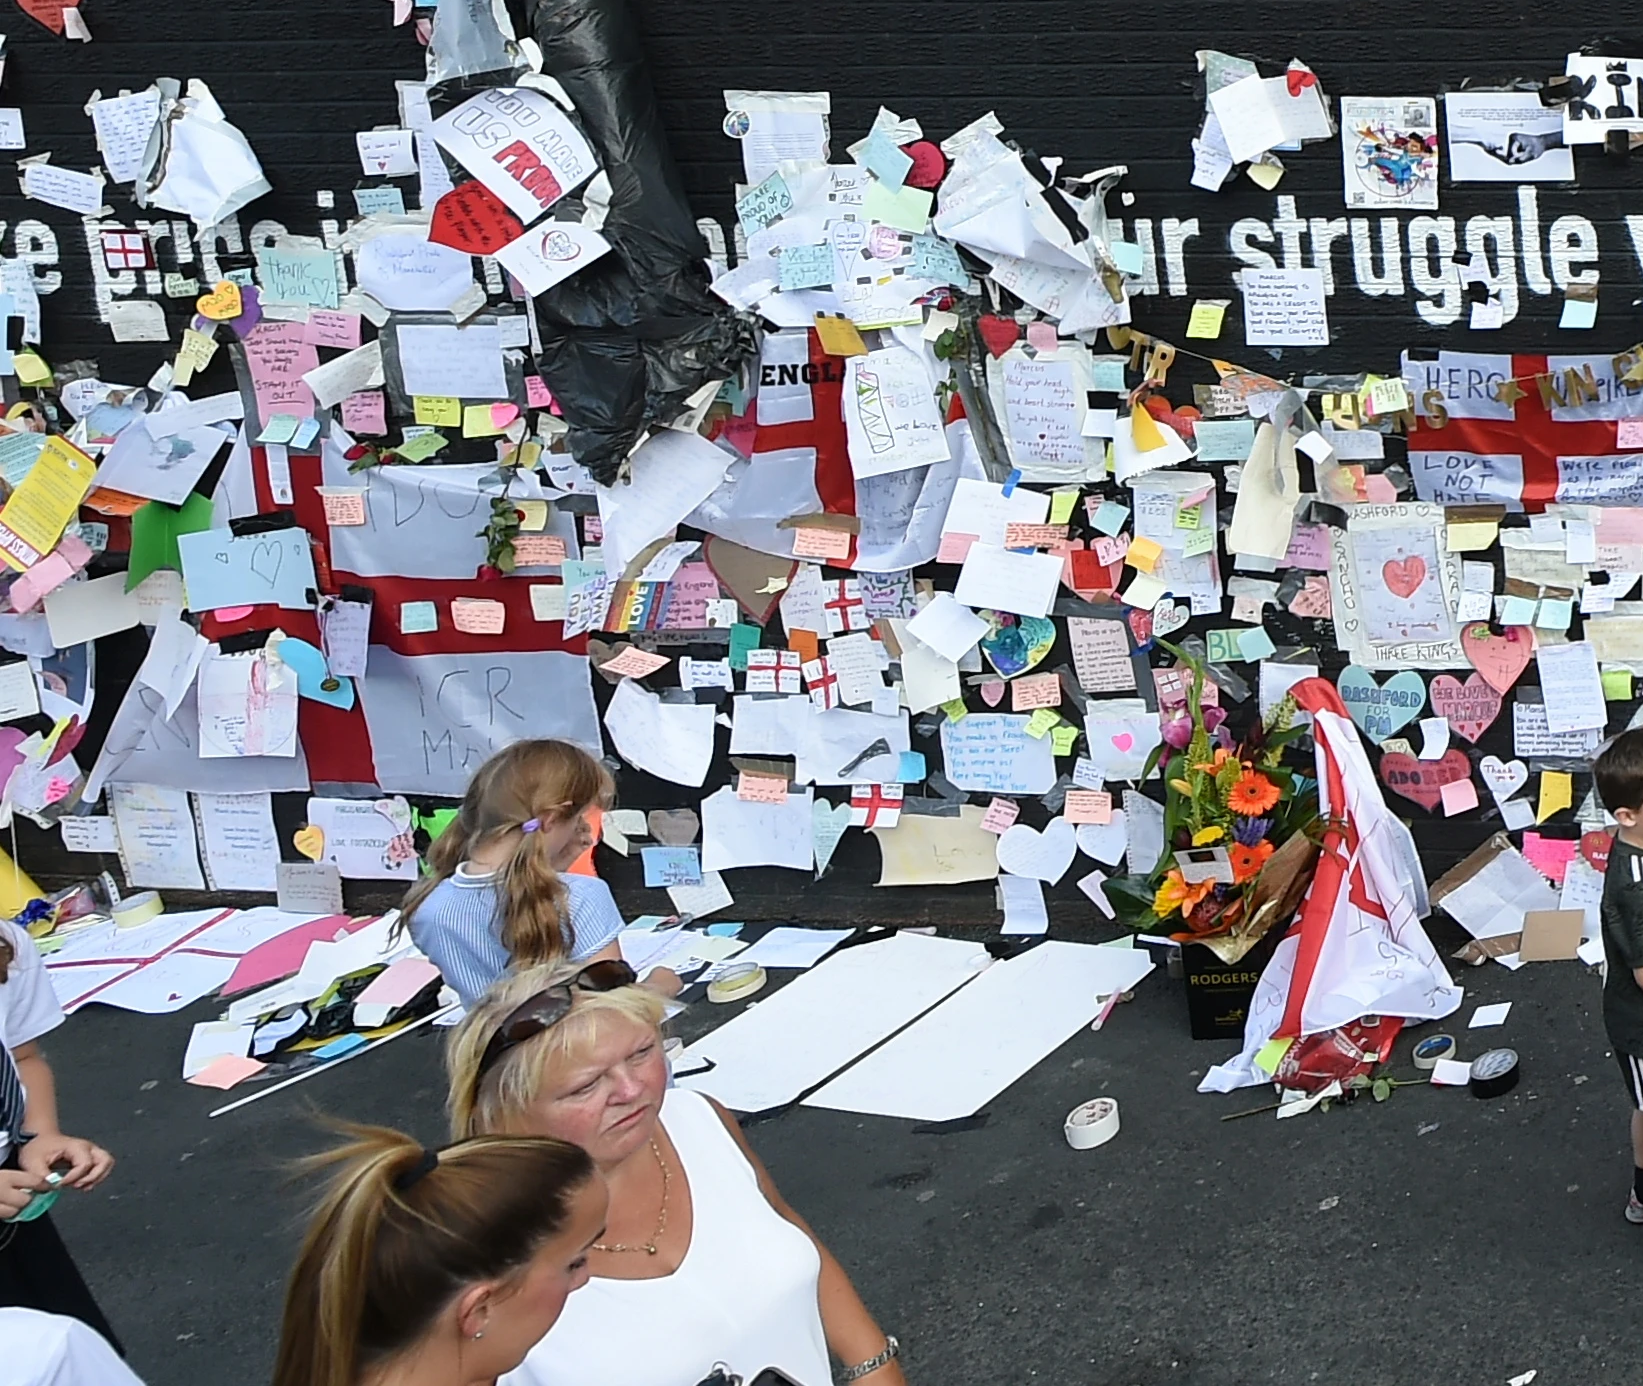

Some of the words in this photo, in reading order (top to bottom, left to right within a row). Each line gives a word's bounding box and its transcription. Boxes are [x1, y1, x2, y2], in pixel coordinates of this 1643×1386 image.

[452, 105, 512, 150] US
[533, 129, 584, 182] MADE
[1230, 184, 1600, 325] struggle
[760, 364, 844, 387] ENGL
[1426, 366, 1506, 403] HERO
[272, 391, 296, 399] OUT
[1424, 455, 1494, 471] LOVE
[1444, 472, 1494, 491] NOT
[1434, 491, 1492, 504] HATE
[626, 581, 650, 628] LOVE
[1416, 641, 1458, 661] KINGS
[1341, 684, 1422, 708] RASHFORD
[1366, 705, 1390, 716] FOR
[1442, 701, 1498, 722] MARCUS
[1364, 715, 1392, 736] PM
[1484, 765, 1514, 775] Thank
[1495, 774, 1507, 782] you
[1190, 971, 1258, 985] RODGERS
